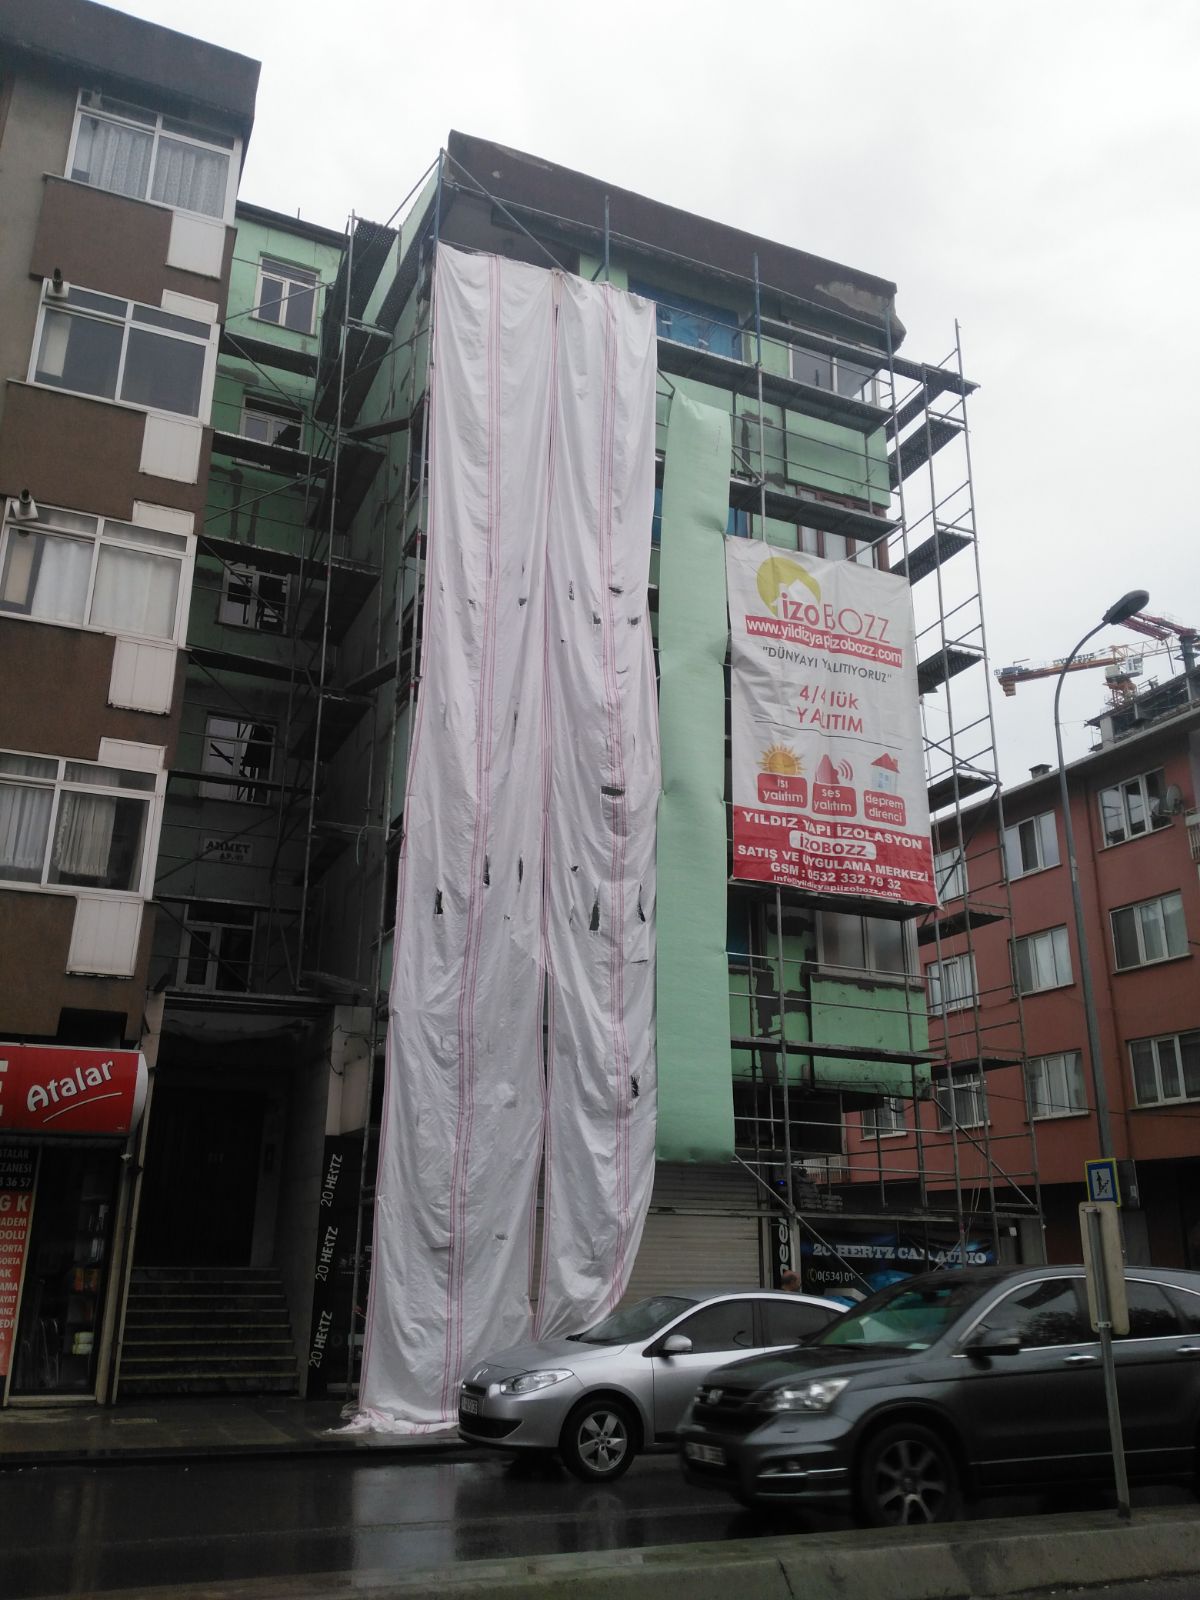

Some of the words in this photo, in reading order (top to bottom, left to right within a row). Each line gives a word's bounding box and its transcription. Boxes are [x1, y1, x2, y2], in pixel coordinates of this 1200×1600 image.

[822, 787, 840, 798] ses
[865, 793, 904, 811] deprem
[869, 807, 903, 823] direnci
[742, 811, 799, 829] YILDIZ
[803, 820, 831, 836] YAPI
[837, 824, 923, 850] İZOLASYON
[737, 845, 778, 861] SATIŞ
[782, 851, 799, 862] VE
[803, 856, 872, 873] UYGULAMA
[876, 865, 929, 882] MERKEZİ
[770, 862, 799, 876] GSM
[808, 869, 836, 883] 0532
[840, 872, 866, 885] 332
[870, 875, 884, 887] 79
[887, 879, 902, 890] 32
[27, 1060, 114, 1112] Atalar
[320, 1190, 334, 1207] 20
[836, 1244, 896, 1259] HERTZ
[315, 1265, 329, 1282] 20
[309, 1351, 323, 1368] 20
